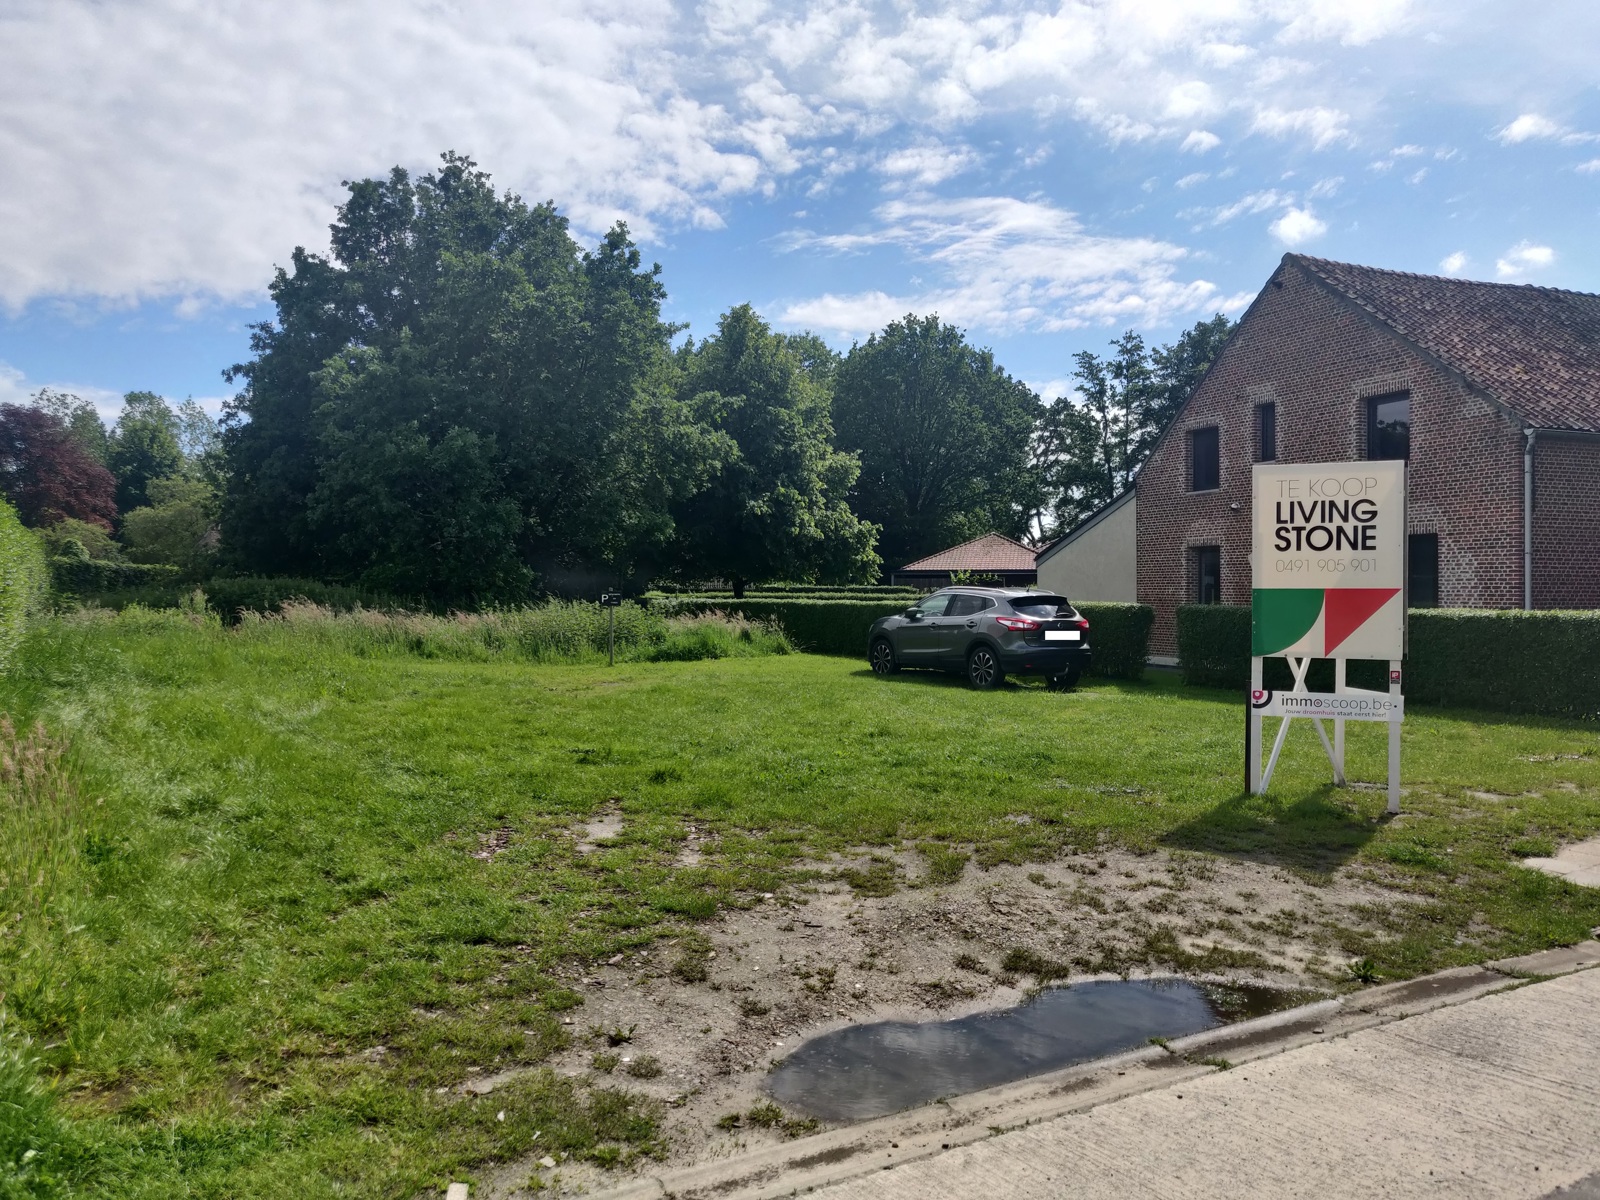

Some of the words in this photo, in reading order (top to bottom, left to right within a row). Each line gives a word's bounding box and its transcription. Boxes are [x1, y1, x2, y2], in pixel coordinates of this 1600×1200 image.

[1276, 480, 1300, 498] TE
[1309, 477, 1378, 497] KOOP
[1276, 499, 1378, 524] LIVING
[1274, 525, 1377, 552] STONE
[1275, 559, 1310, 572] 0491
[1317, 559, 1346, 572] 905
[1351, 559, 1377, 572] 901
[601, 594, 609, 603] P
[1281, 694, 1393, 711] immoscoop.be
[1302, 708, 1335, 716] droomhuis
